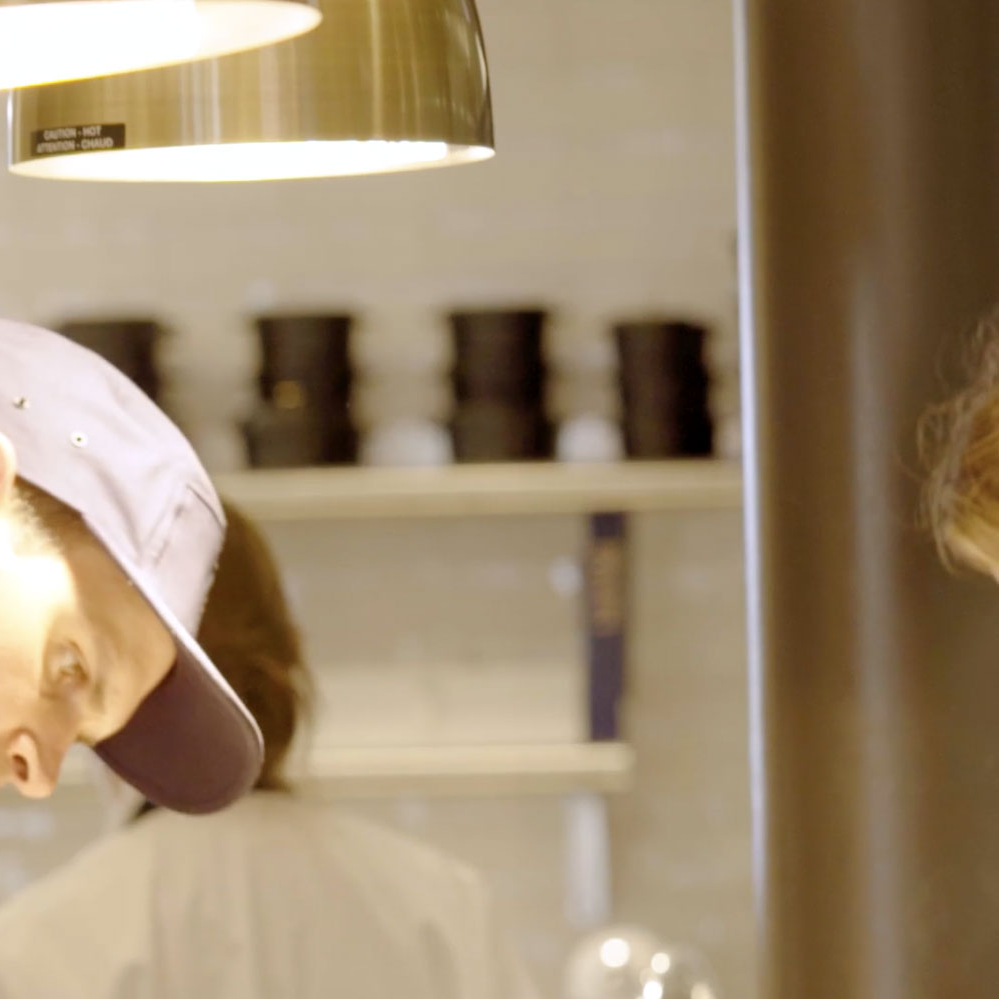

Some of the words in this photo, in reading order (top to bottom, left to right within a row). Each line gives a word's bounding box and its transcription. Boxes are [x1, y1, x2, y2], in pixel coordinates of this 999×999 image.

[43, 127, 77, 141] CAUTION
[82, 125, 102, 137] HOT
[81, 136, 114, 150] CHAUD
